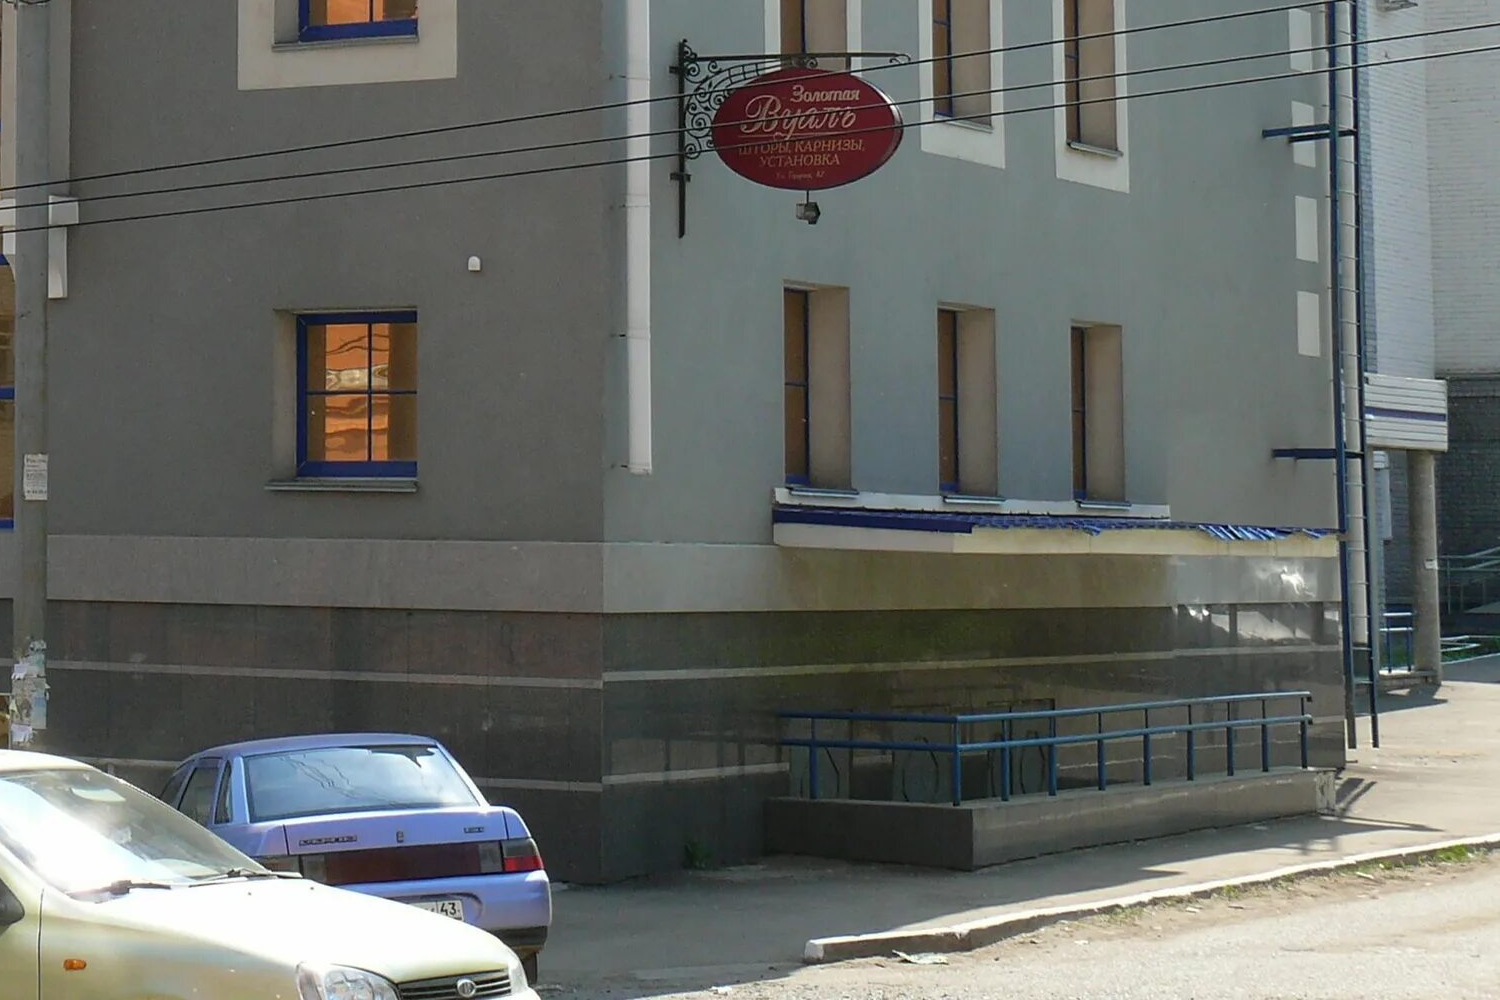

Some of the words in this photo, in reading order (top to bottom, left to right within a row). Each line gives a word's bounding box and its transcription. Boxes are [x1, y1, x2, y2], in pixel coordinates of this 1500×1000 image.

[790, 84, 860, 103] Золотая
[740, 94, 856, 141] Вуаль
[760, 153, 841, 168] УСТАНОВКА
